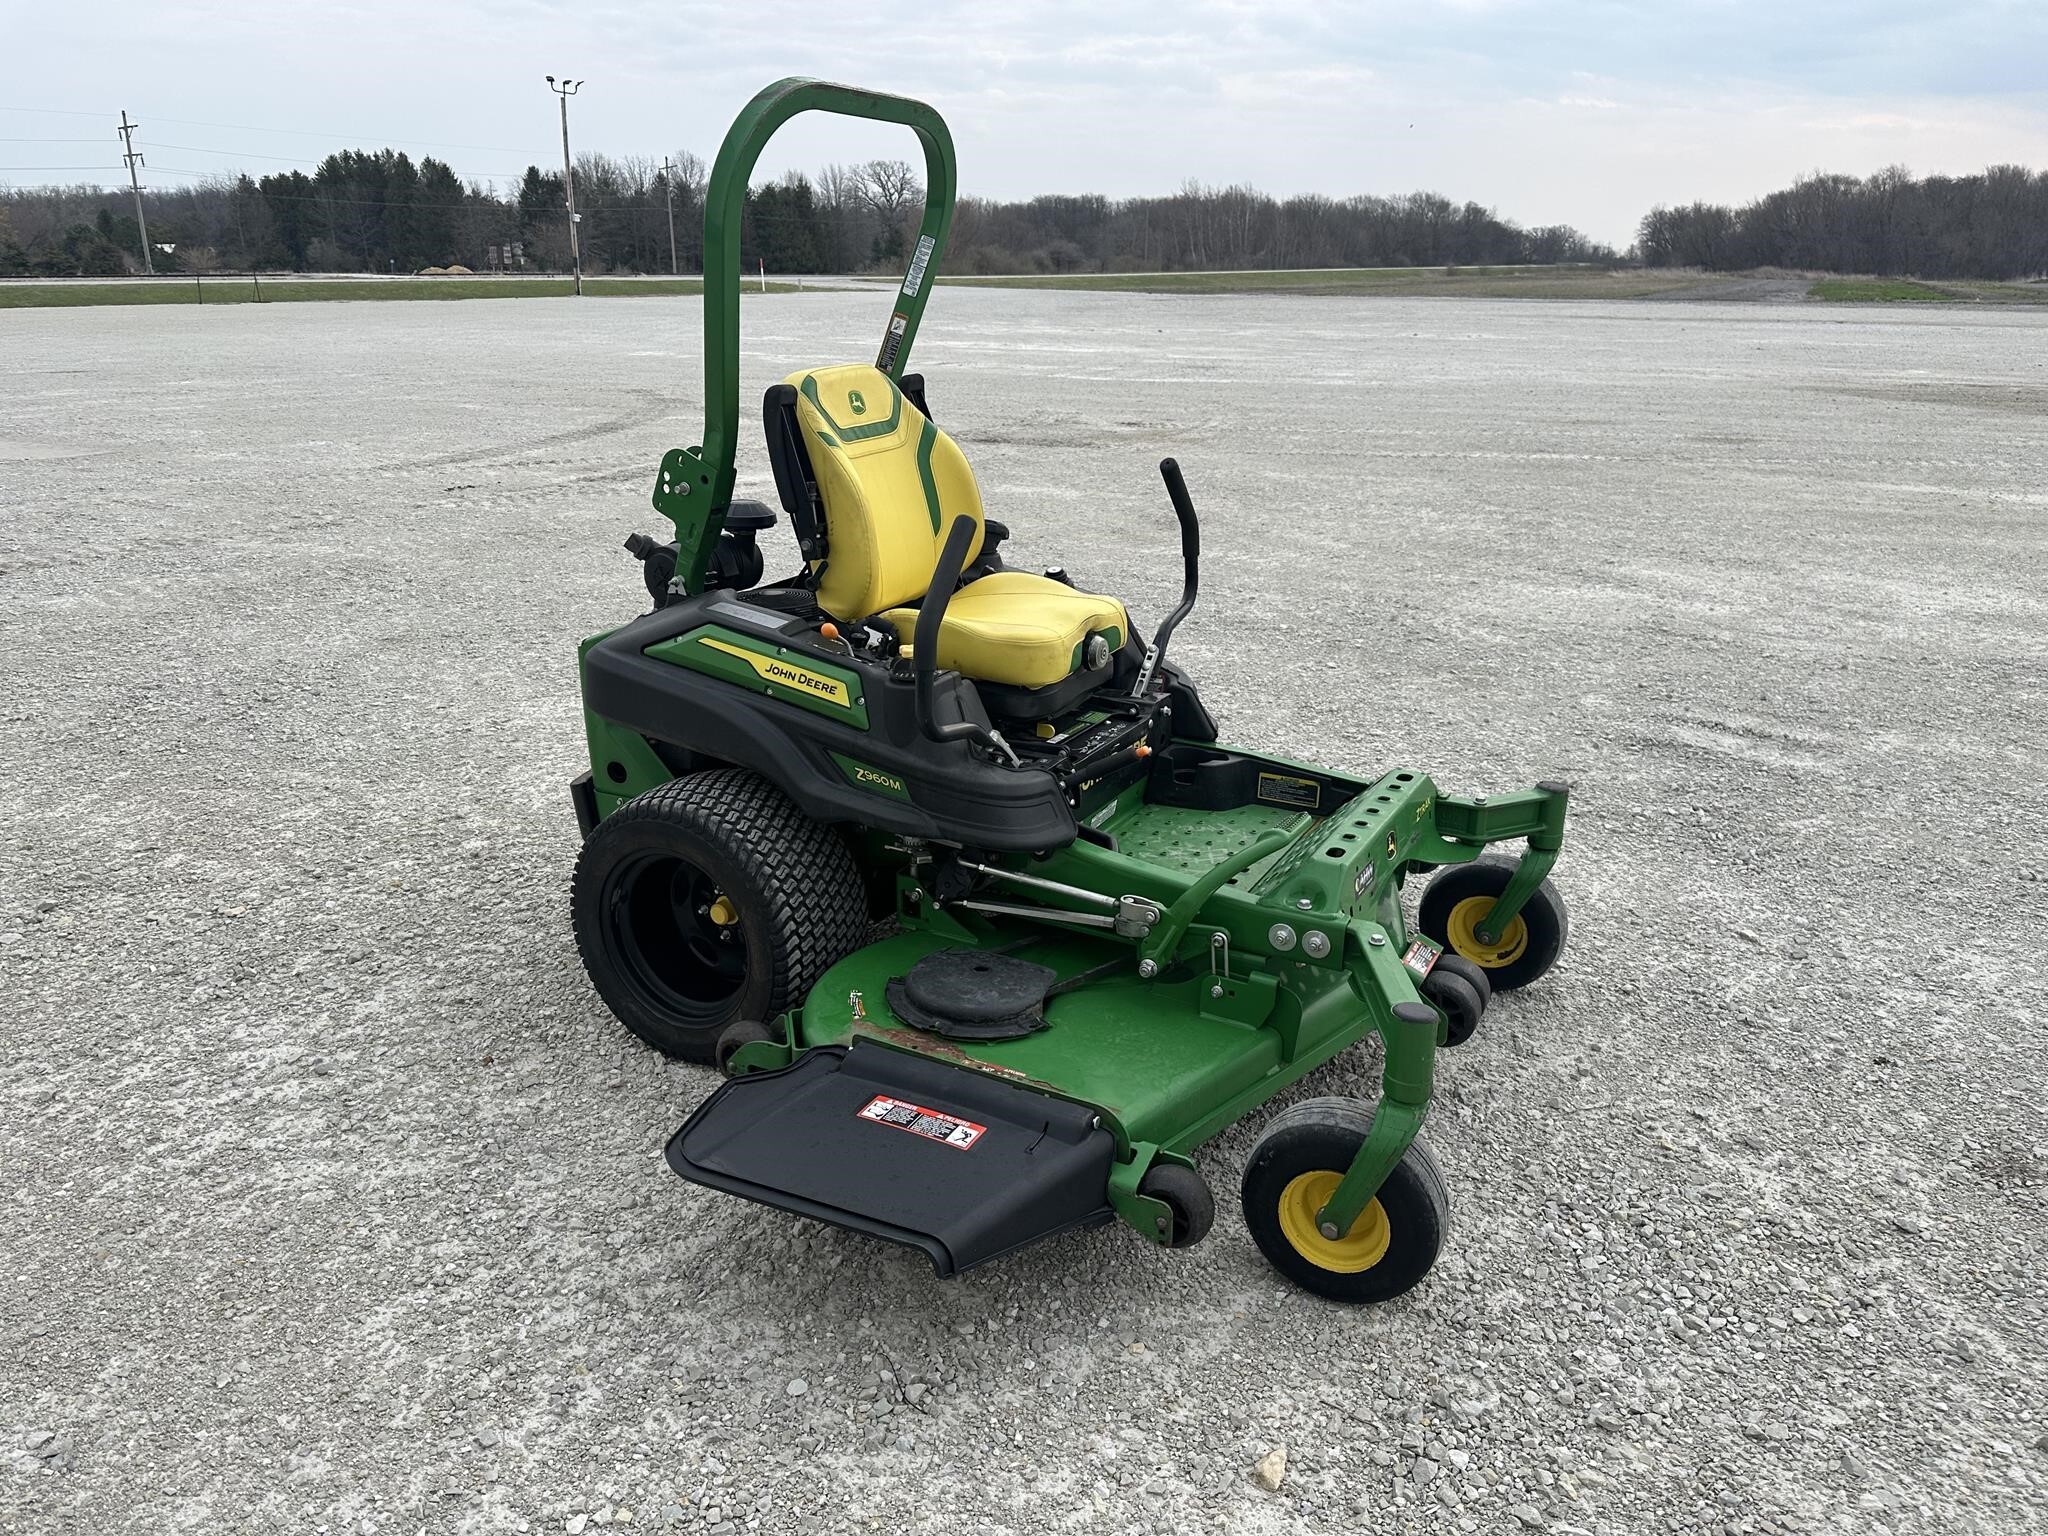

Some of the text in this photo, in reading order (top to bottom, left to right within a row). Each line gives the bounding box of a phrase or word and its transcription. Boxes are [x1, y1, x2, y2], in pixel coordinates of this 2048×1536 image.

[765, 663, 838, 695] JOHN DEERE
[854, 766, 901, 791] Z960M
